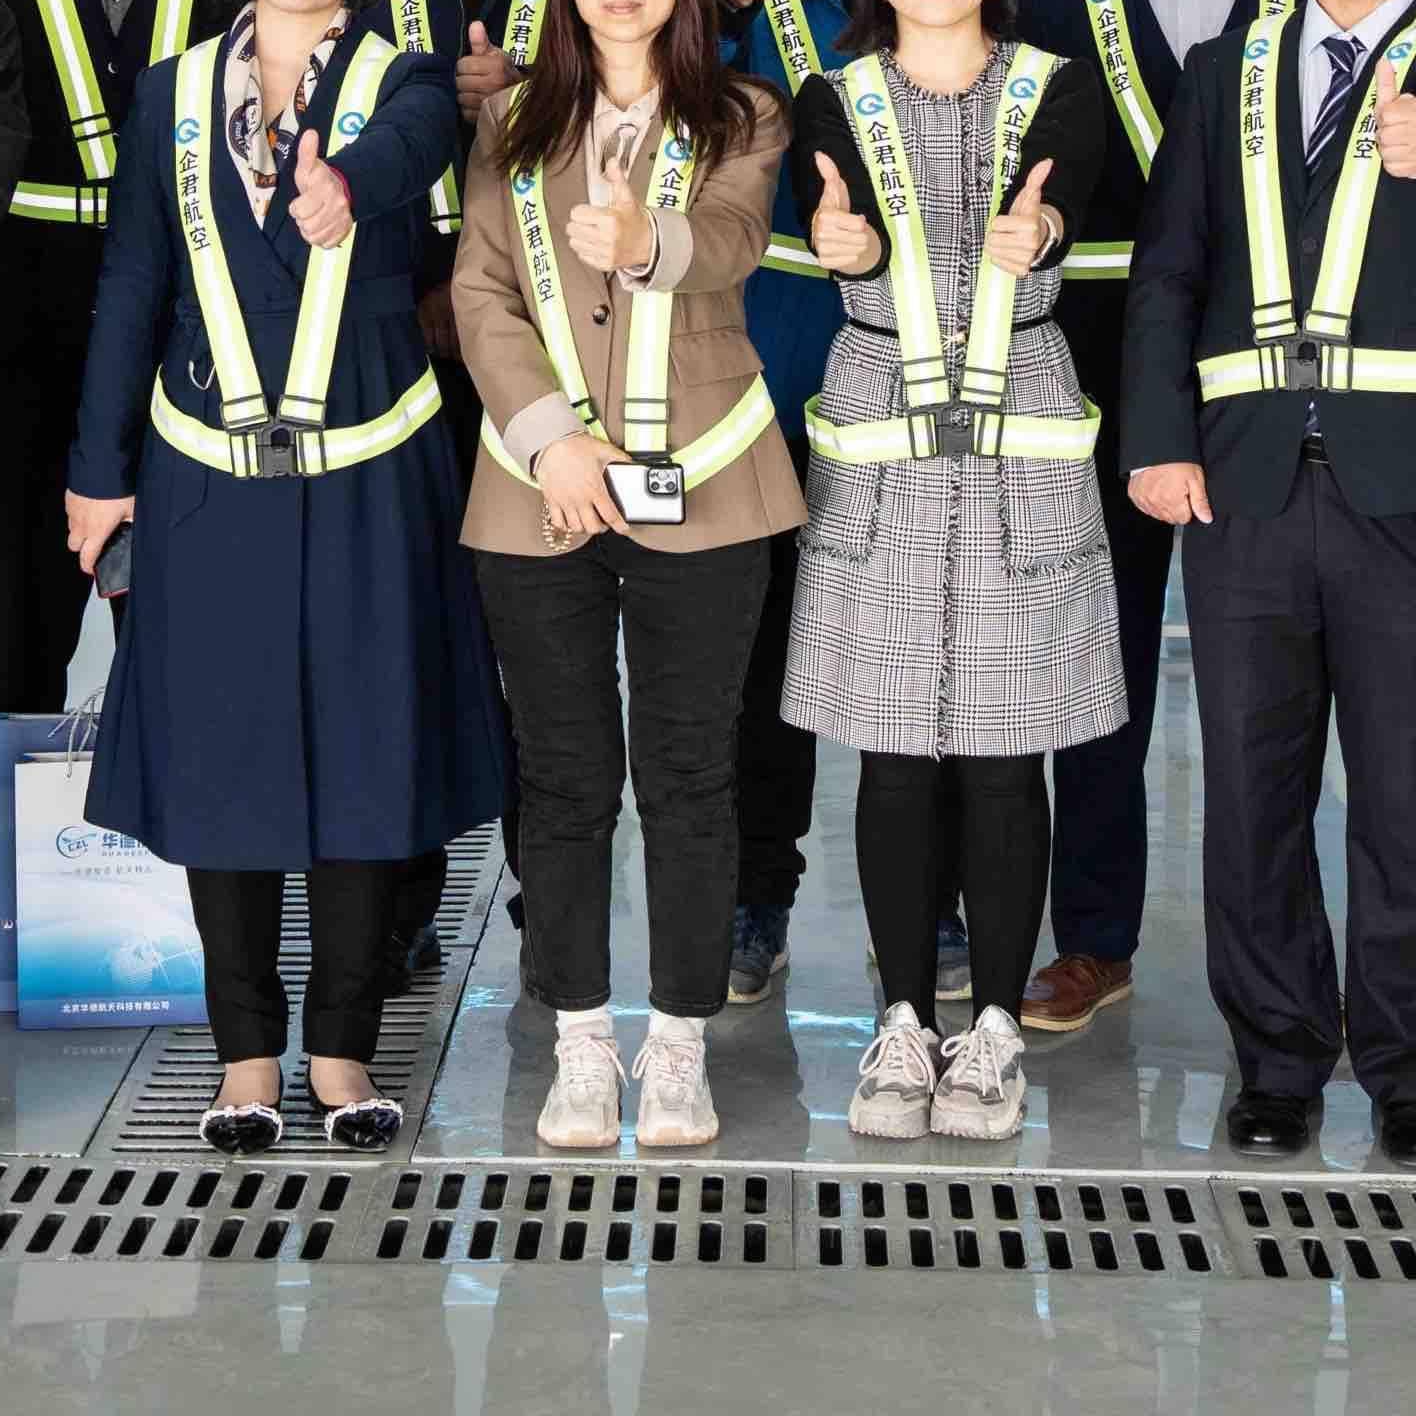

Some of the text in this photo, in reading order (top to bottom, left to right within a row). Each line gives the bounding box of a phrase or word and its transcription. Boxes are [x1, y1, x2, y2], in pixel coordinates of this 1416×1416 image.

[1097, 7, 1130, 94] 企君航空
[1242, 64, 1266, 157] 企君航空
[178, 150, 210, 250] 企君航空
[865, 120, 909, 218] 企君航空
[520, 201, 555, 302] 企君航空
[103, 832, 142, 848] 华德
